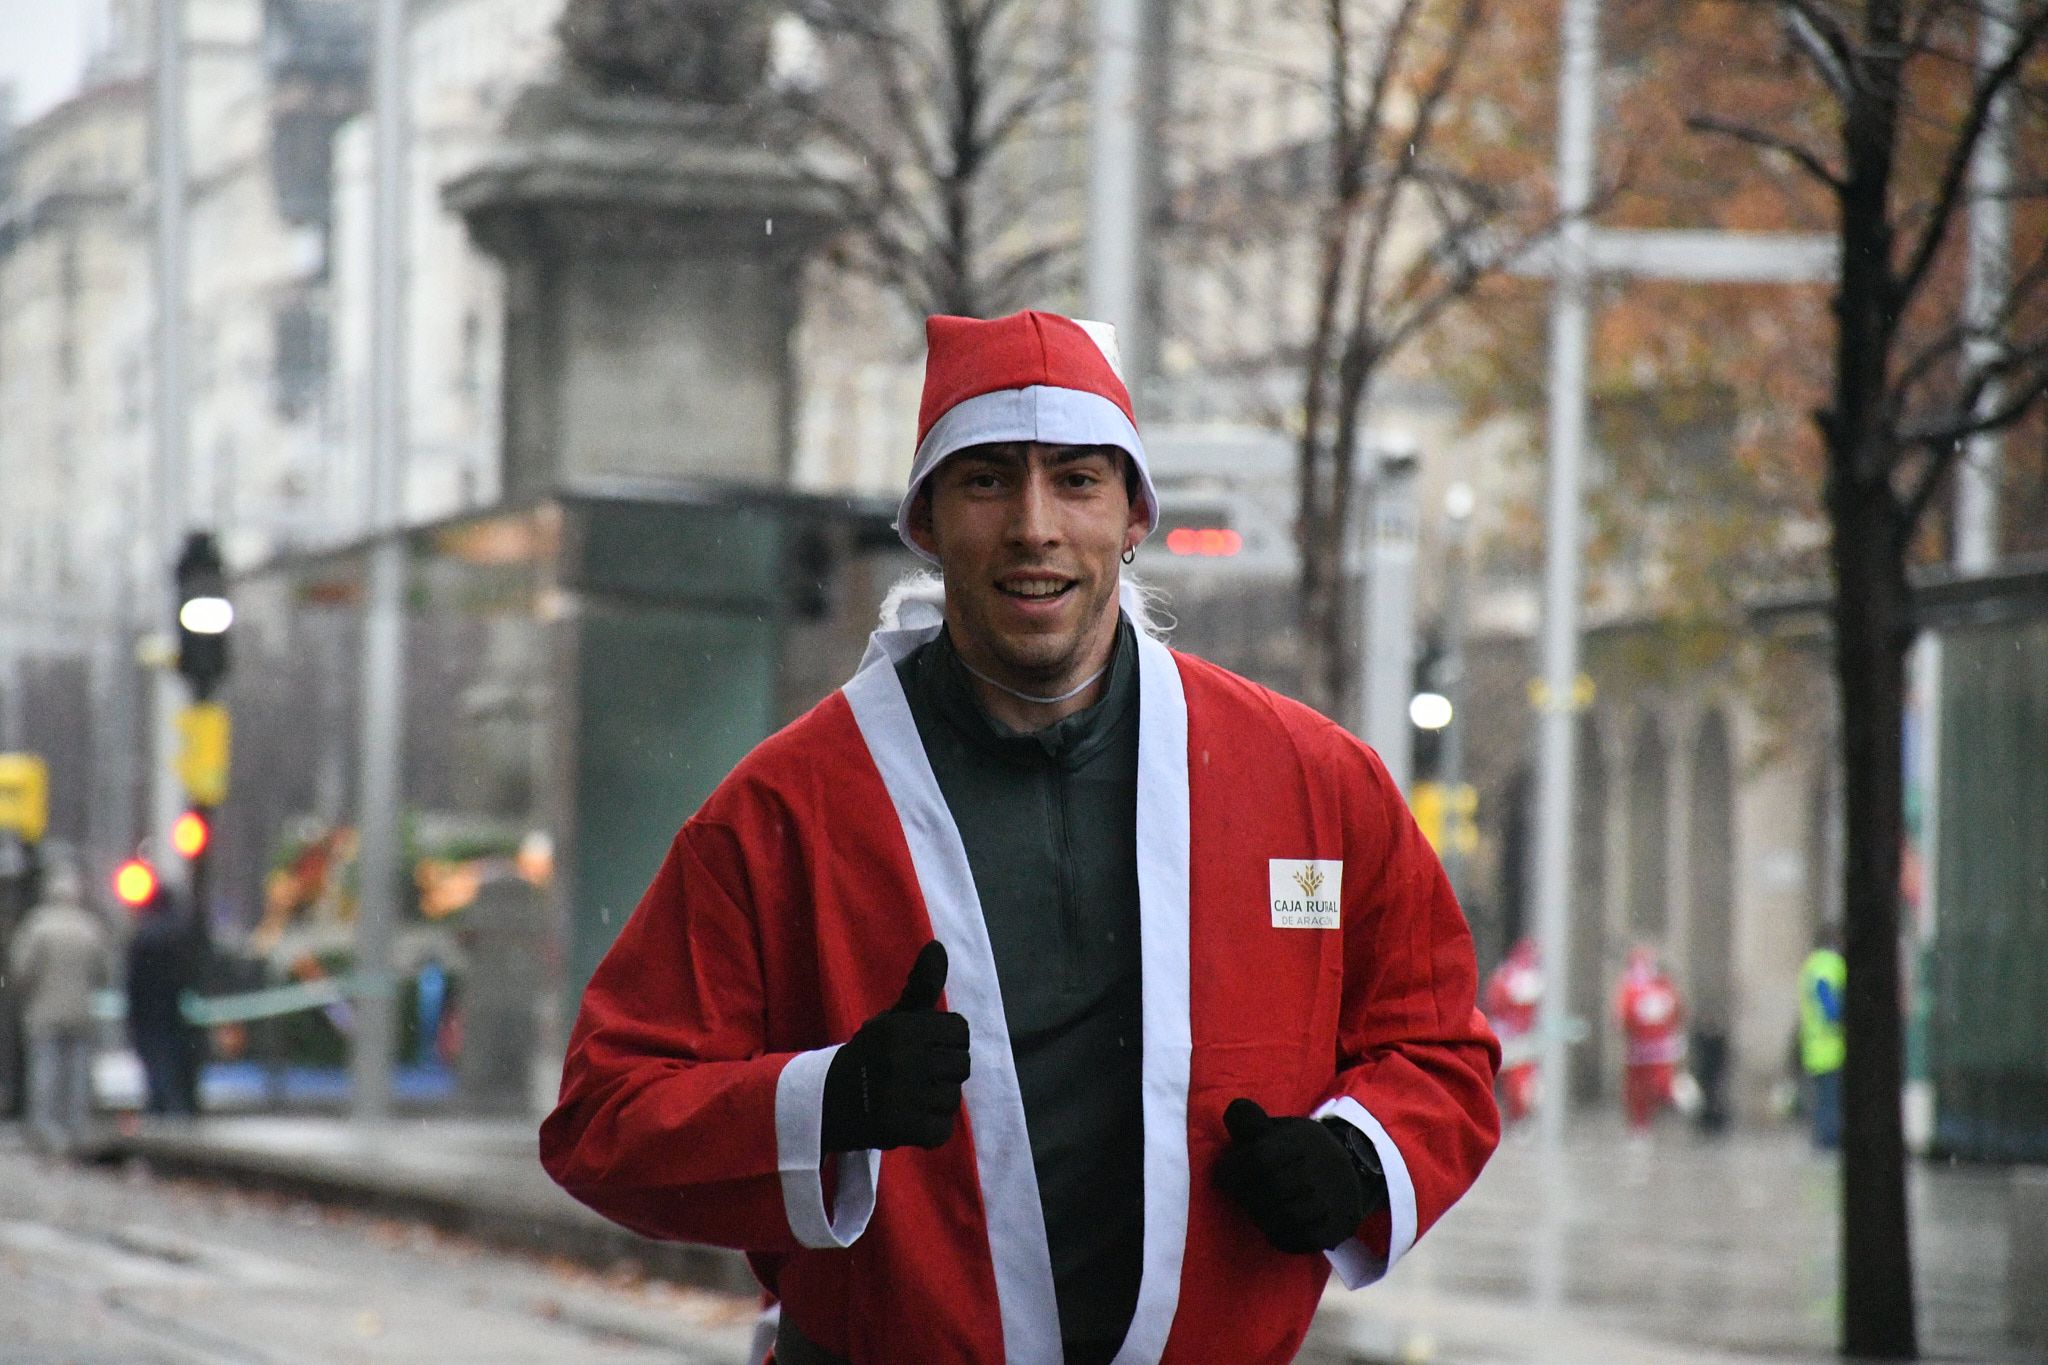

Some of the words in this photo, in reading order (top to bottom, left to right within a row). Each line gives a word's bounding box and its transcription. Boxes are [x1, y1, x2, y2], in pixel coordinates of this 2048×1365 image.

[1274, 900, 1302, 912] CAJA
[1306, 901, 1338, 912] RURAL
[1281, 916, 1293, 926] DE
